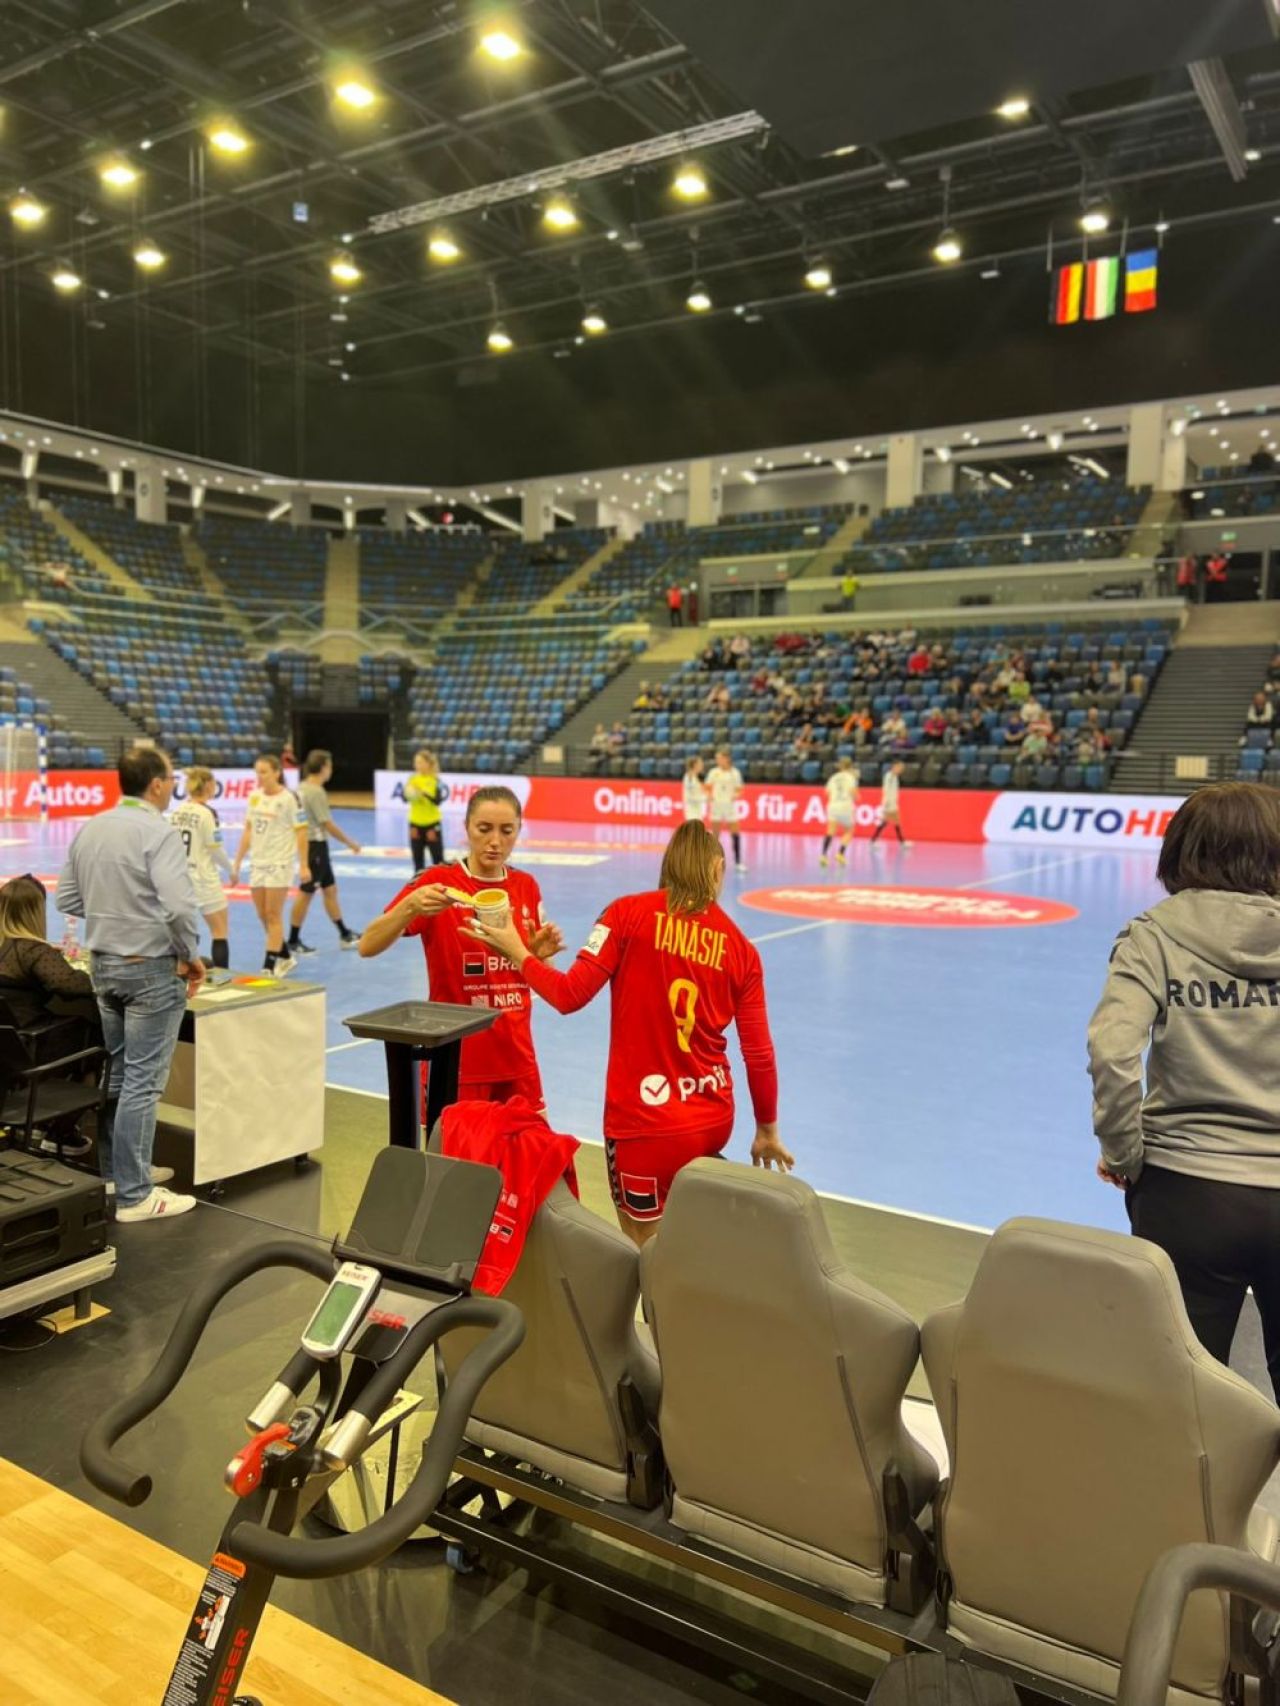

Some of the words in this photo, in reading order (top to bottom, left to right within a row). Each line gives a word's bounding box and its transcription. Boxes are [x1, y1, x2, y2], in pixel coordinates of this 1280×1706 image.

[756, 795, 797, 823] für
[494, 992, 522, 1007] NIRO
[668, 978, 698, 1053] 9
